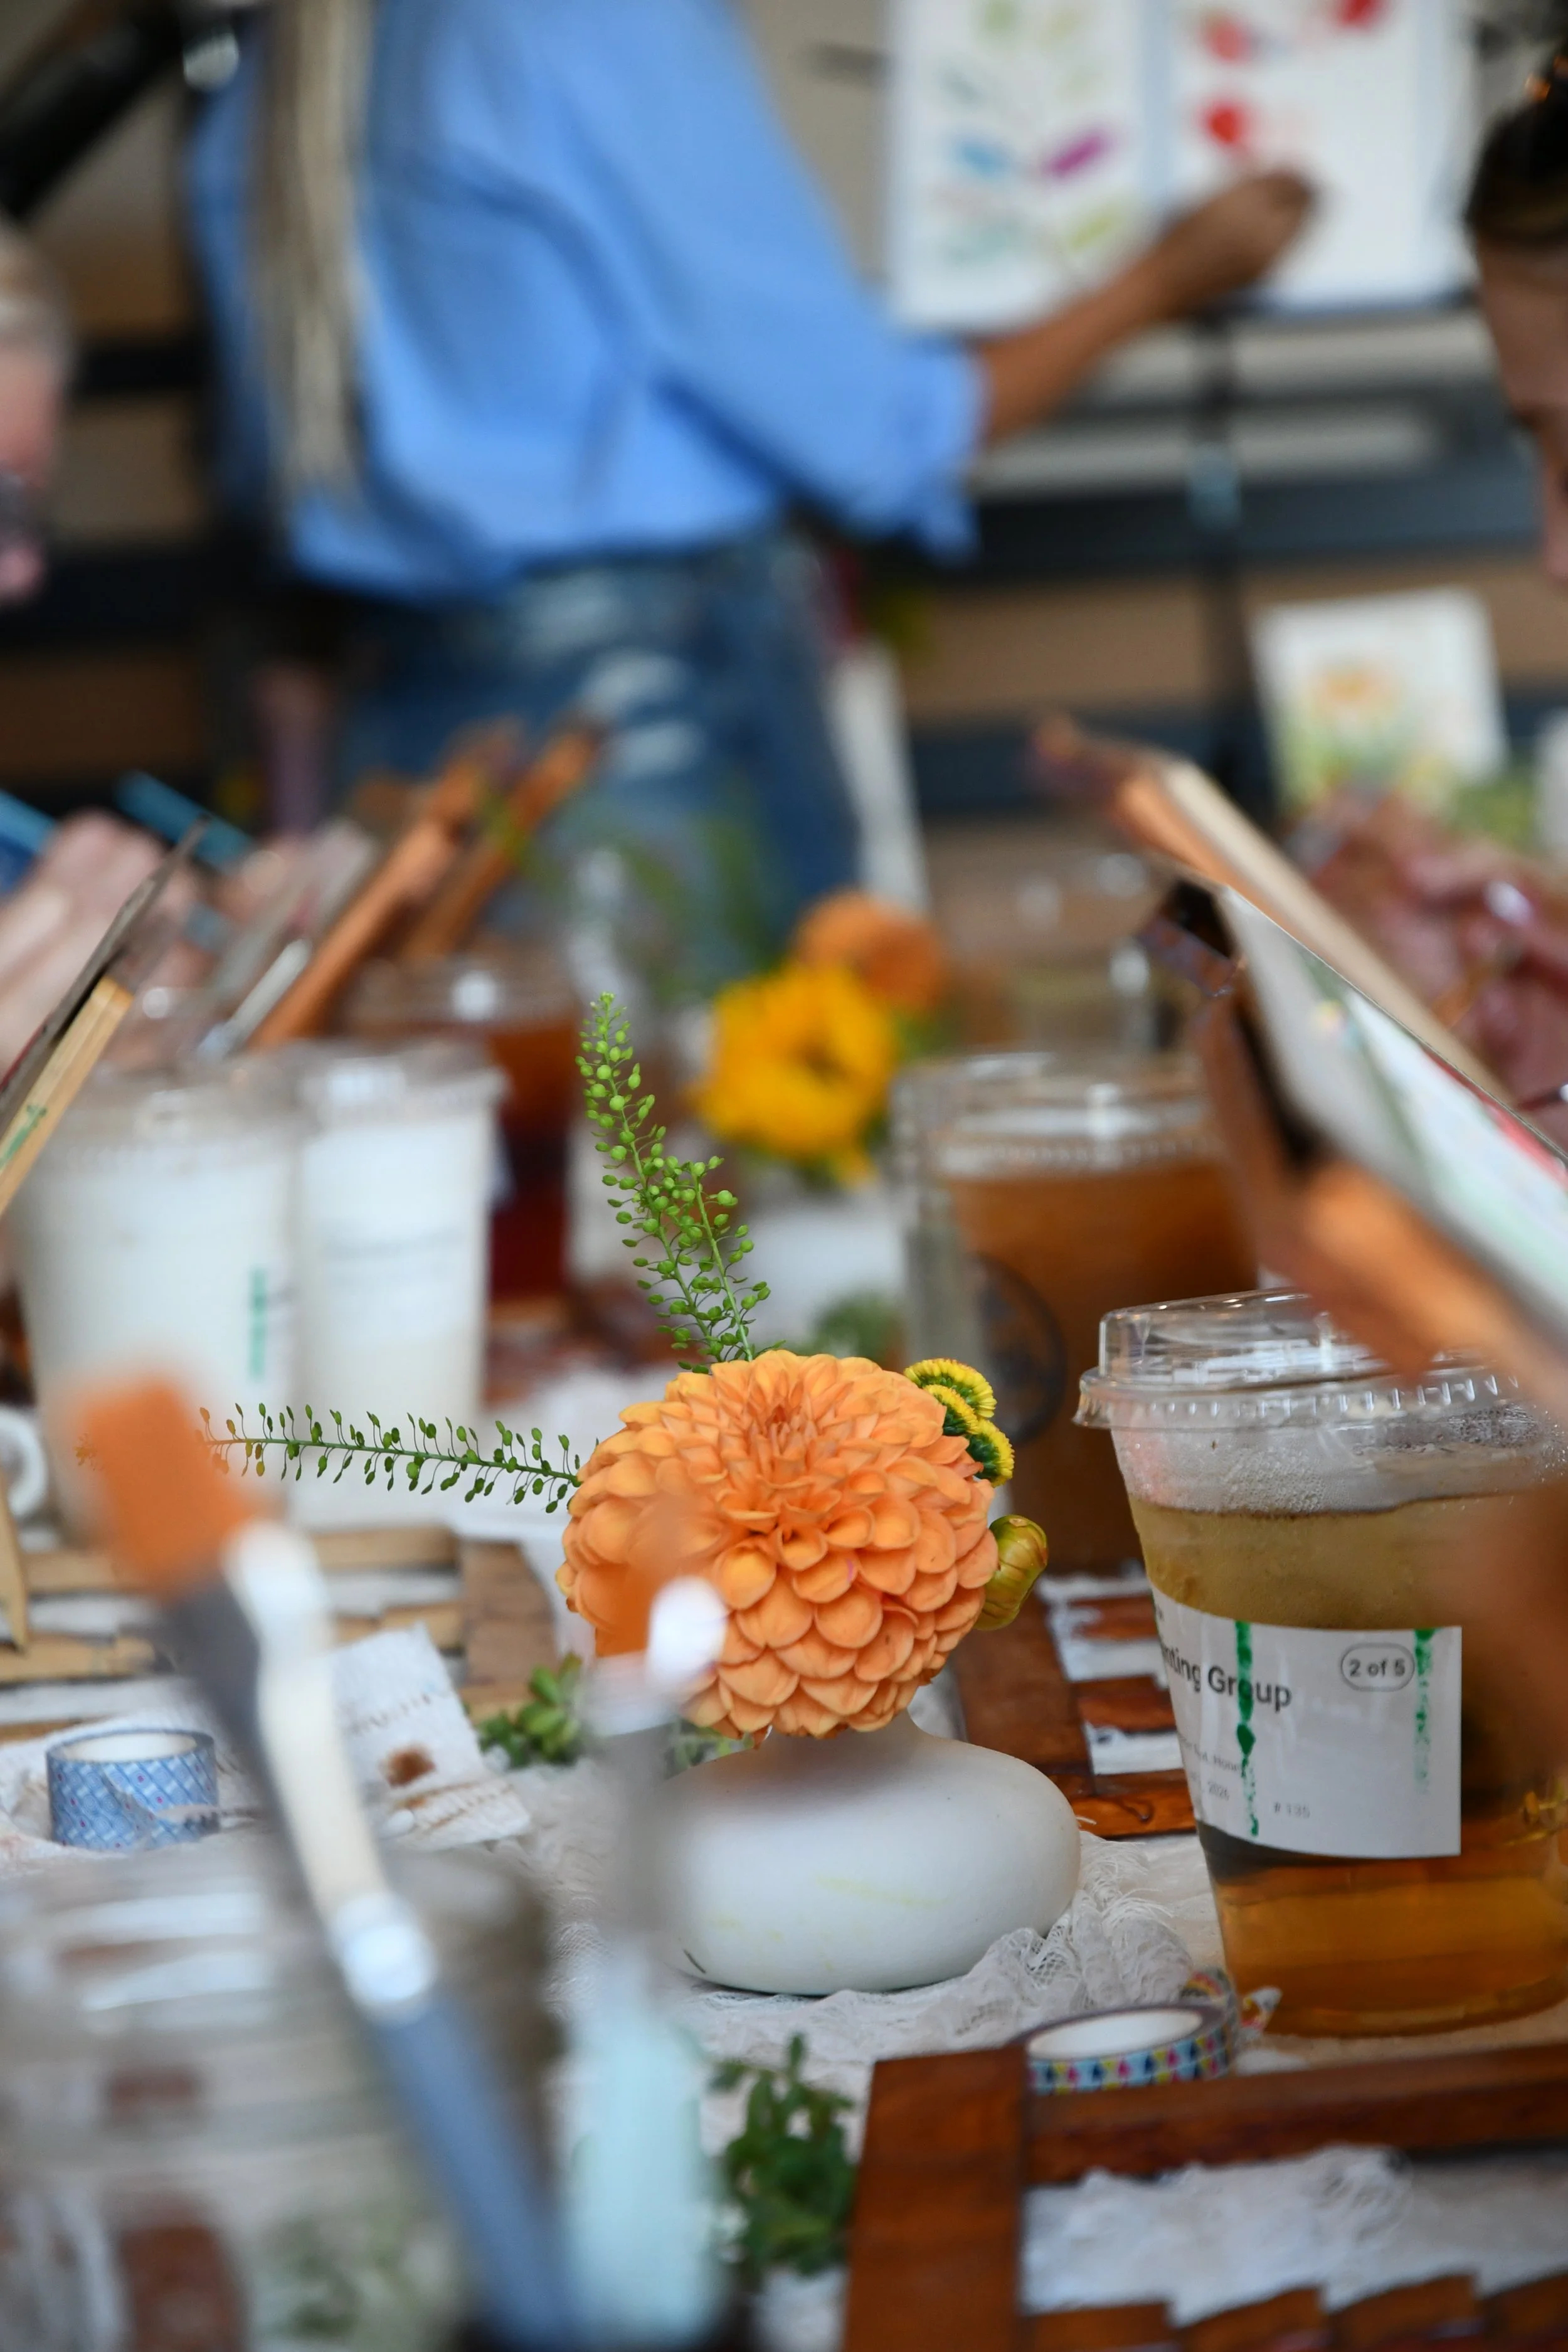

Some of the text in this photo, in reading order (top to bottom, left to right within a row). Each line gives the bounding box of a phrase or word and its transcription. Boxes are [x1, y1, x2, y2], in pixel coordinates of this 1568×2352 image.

[1349, 1658, 1405, 1677] 2 of 5
[1208, 1665, 1291, 1713] Group
